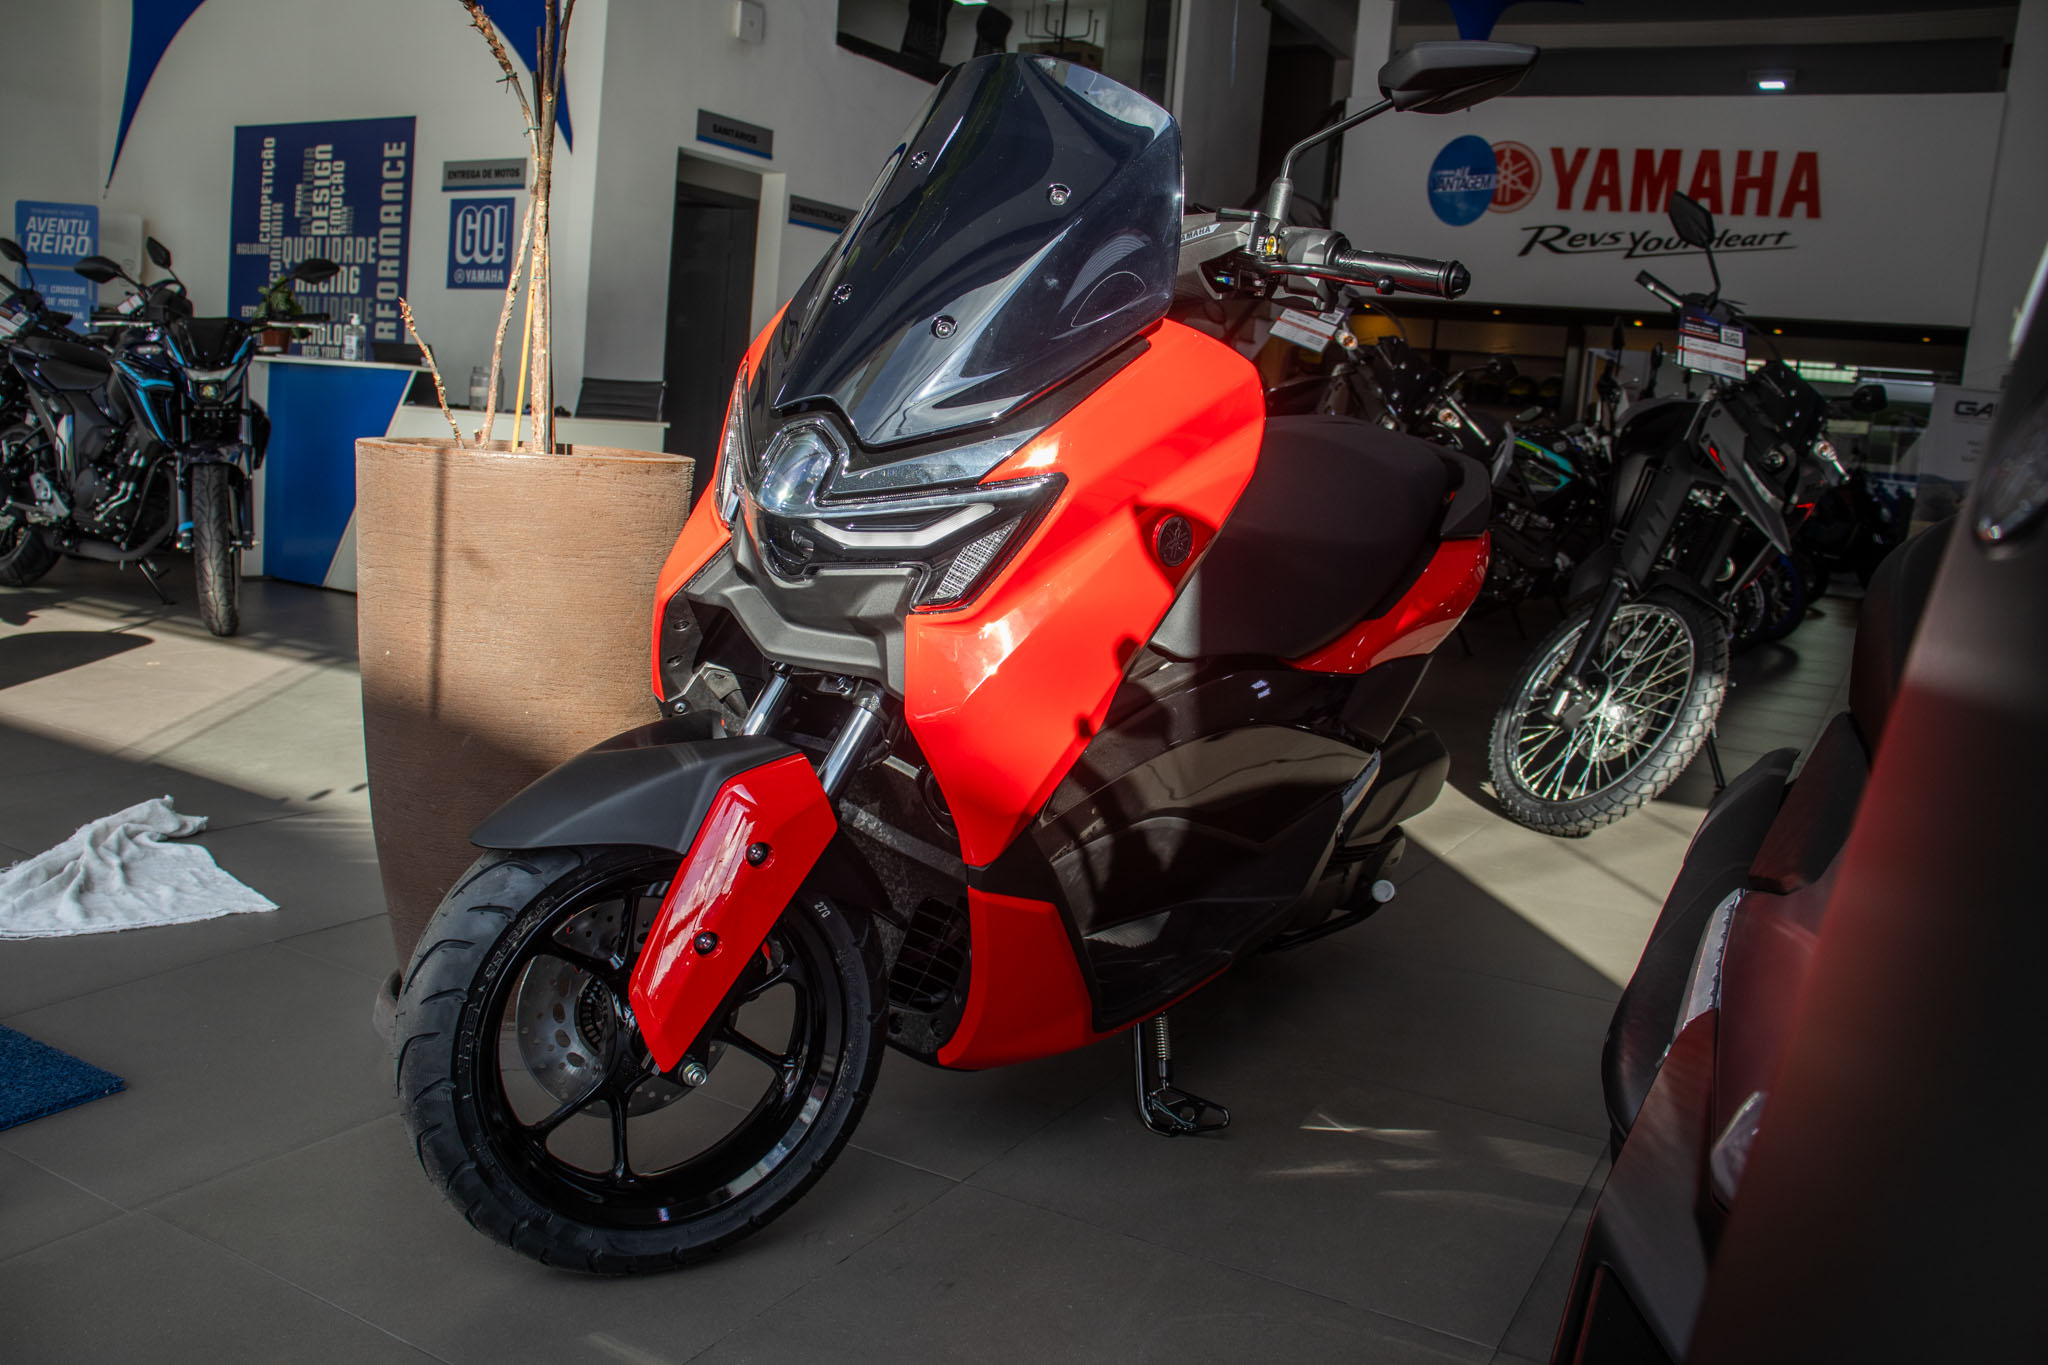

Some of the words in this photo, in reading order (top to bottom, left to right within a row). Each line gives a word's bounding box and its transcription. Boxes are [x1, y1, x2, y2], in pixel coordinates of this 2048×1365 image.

[447, 169, 480, 180] ENTREGA
[483, 169, 492, 179] DE
[494, 167, 520, 178] MOTOS
[1550, 147, 1822, 219] YAMAHA
[259, 137, 276, 243] COMPETIÇÃO
[328, 160, 346, 235] EMOÇÃO
[25, 215, 90, 235] AVENTU
[374, 141, 407, 340] RFORMANCE
[455, 204, 508, 265] GO!
[1181, 226, 1210, 241] AMAHA
[1518, 225, 1625, 257] Revs
[26, 232, 91, 256] REIRO
[282, 236, 377, 269] QUALIDADE
[465, 268, 504, 284] YAMAHA
